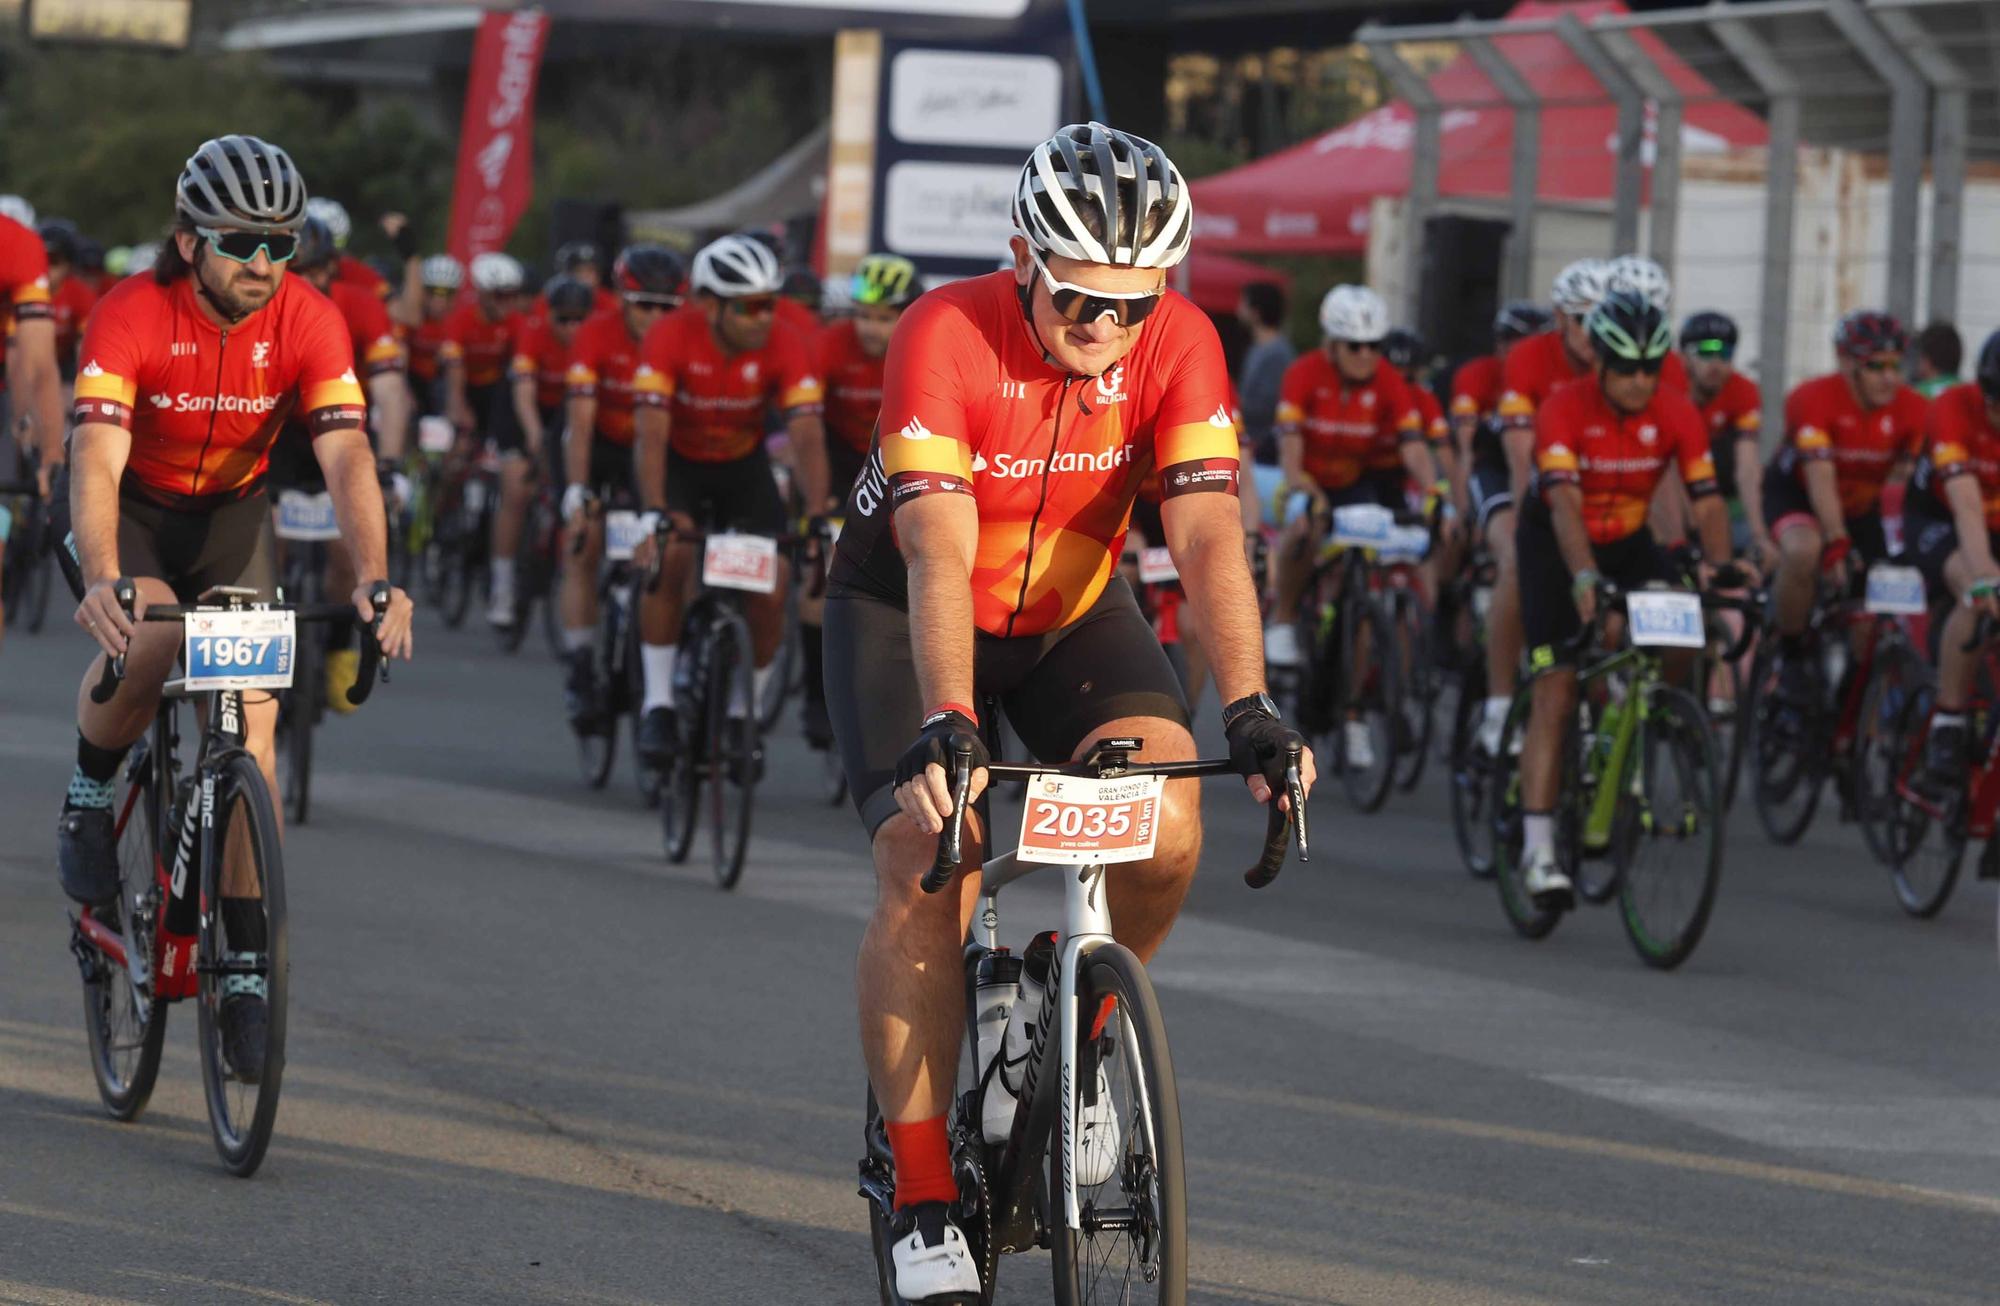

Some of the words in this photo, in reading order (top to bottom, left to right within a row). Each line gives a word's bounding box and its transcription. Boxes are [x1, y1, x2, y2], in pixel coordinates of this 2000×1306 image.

[197, 638, 272, 667] 1967
[202, 777, 215, 828] BMC
[1098, 787, 1118, 795] GRAN
[1032, 802, 1133, 838] 2035
[1139, 801, 1153, 821] km
[1137, 822, 1150, 844] 190
[998, 1006, 1008, 1020] 2
[1062, 1062, 1074, 1194] SPECIALIZED
